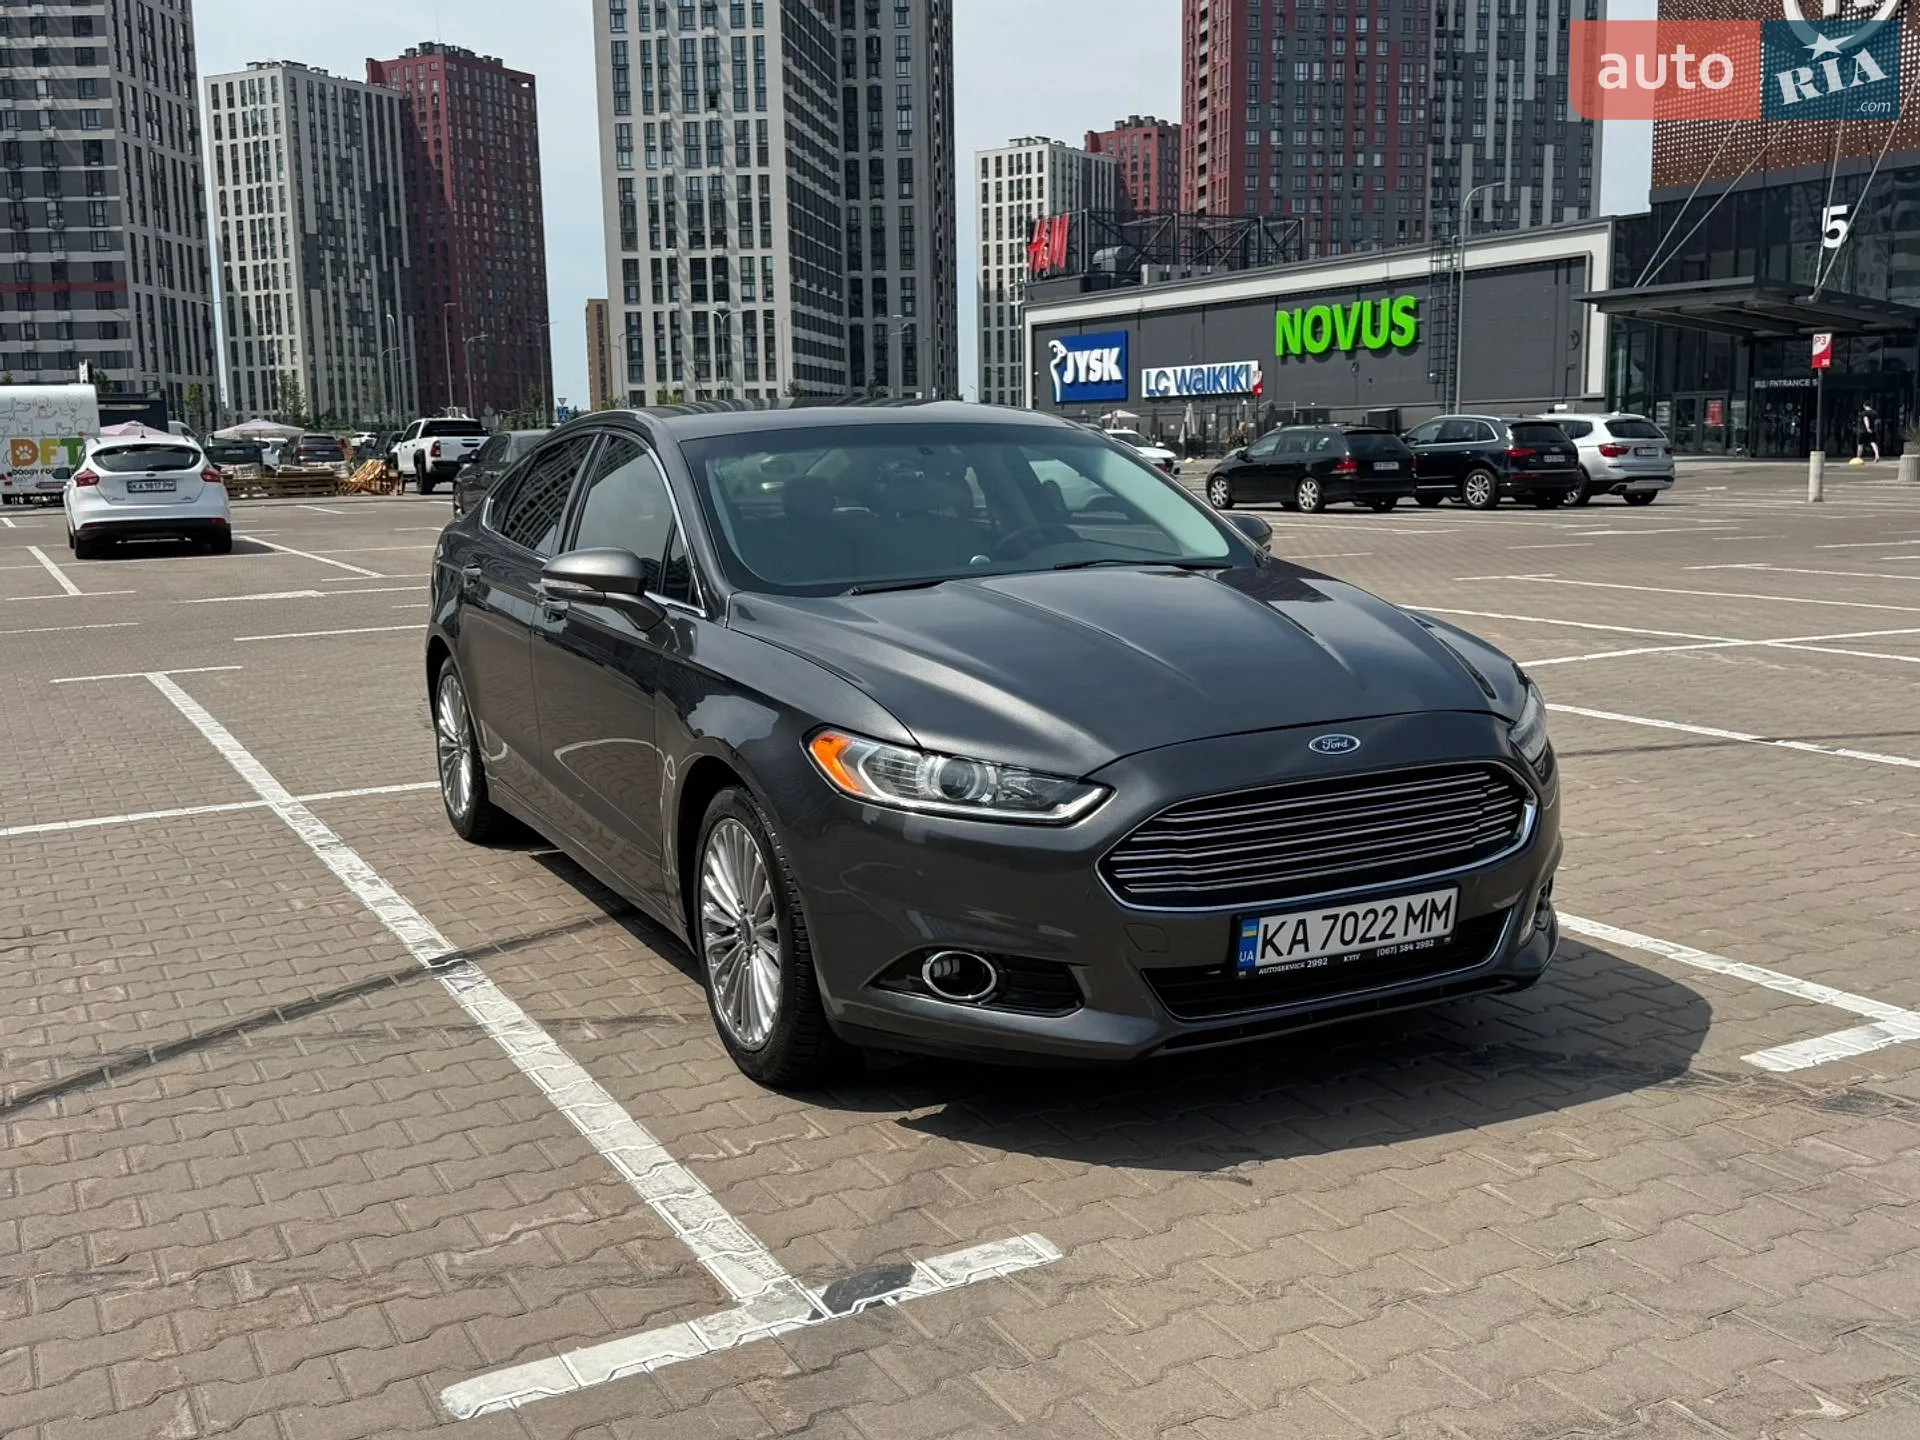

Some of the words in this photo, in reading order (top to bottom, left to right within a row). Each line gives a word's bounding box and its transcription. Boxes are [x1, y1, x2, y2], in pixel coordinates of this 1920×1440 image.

[1821, 205, 1850, 249] 5
[1275, 295, 1416, 356] NOVUS
[1815, 336, 1827, 345] P3
[1063, 347, 1122, 384] JYSK
[1145, 370, 1171, 396] LC
[10, 438, 84, 467] DFT
[1322, 737, 1348, 750] Ford
[1260, 918, 1309, 959] KA
[1320, 905, 1398, 950] 7022
[1403, 895, 1452, 936] MM
[1239, 950, 1254, 962] UA
[1258, 962, 1305, 975] AUTOSERVICE
[1377, 946, 1397, 957] (067)
